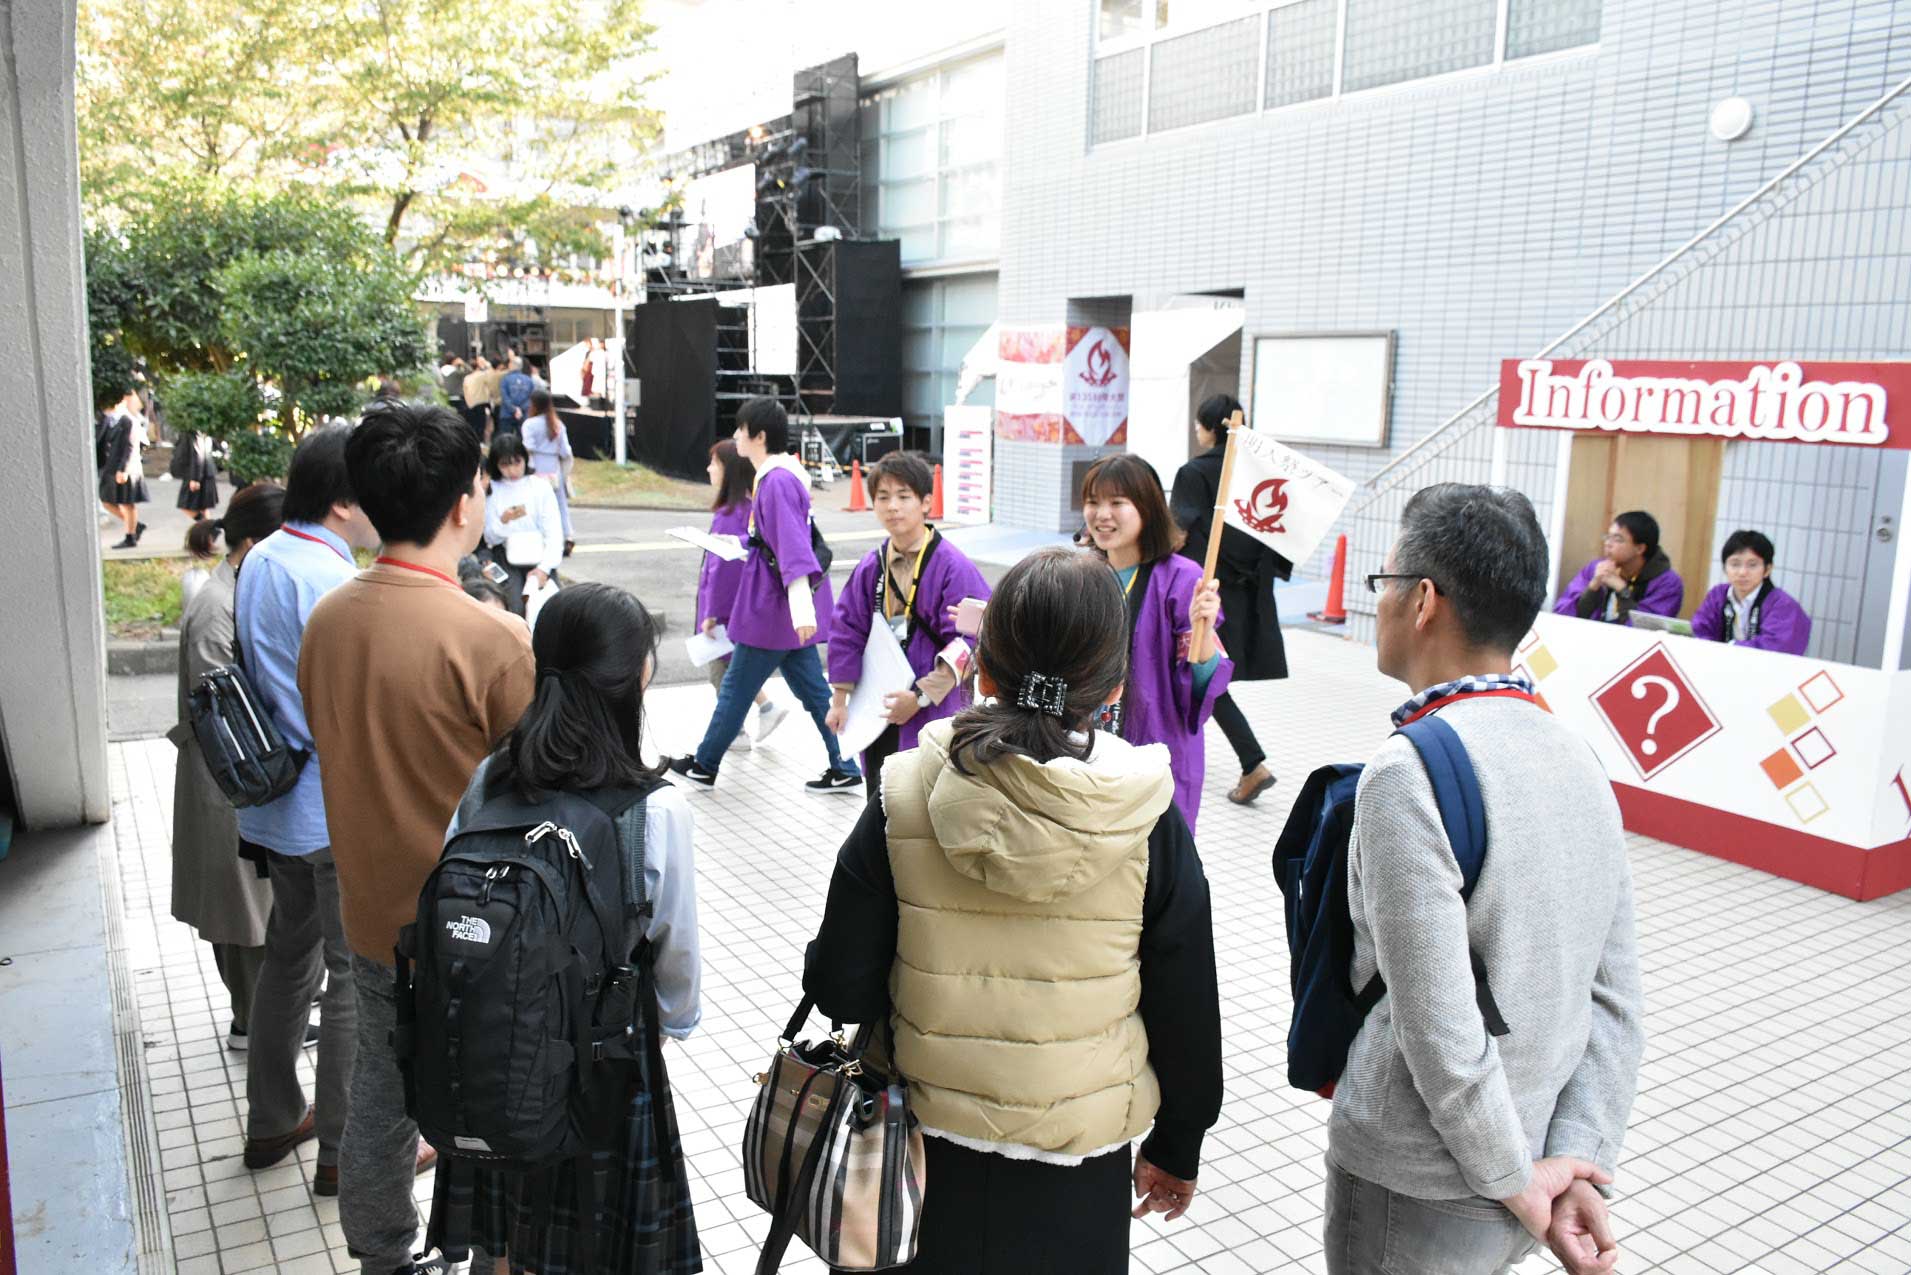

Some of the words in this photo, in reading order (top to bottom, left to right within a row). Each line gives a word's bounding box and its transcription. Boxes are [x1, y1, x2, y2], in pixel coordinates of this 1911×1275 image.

[1520, 364, 1878, 436] Information
[446, 920, 476, 934] NORTH
[460, 915, 479, 926] THE
[451, 929, 476, 942] FACE
